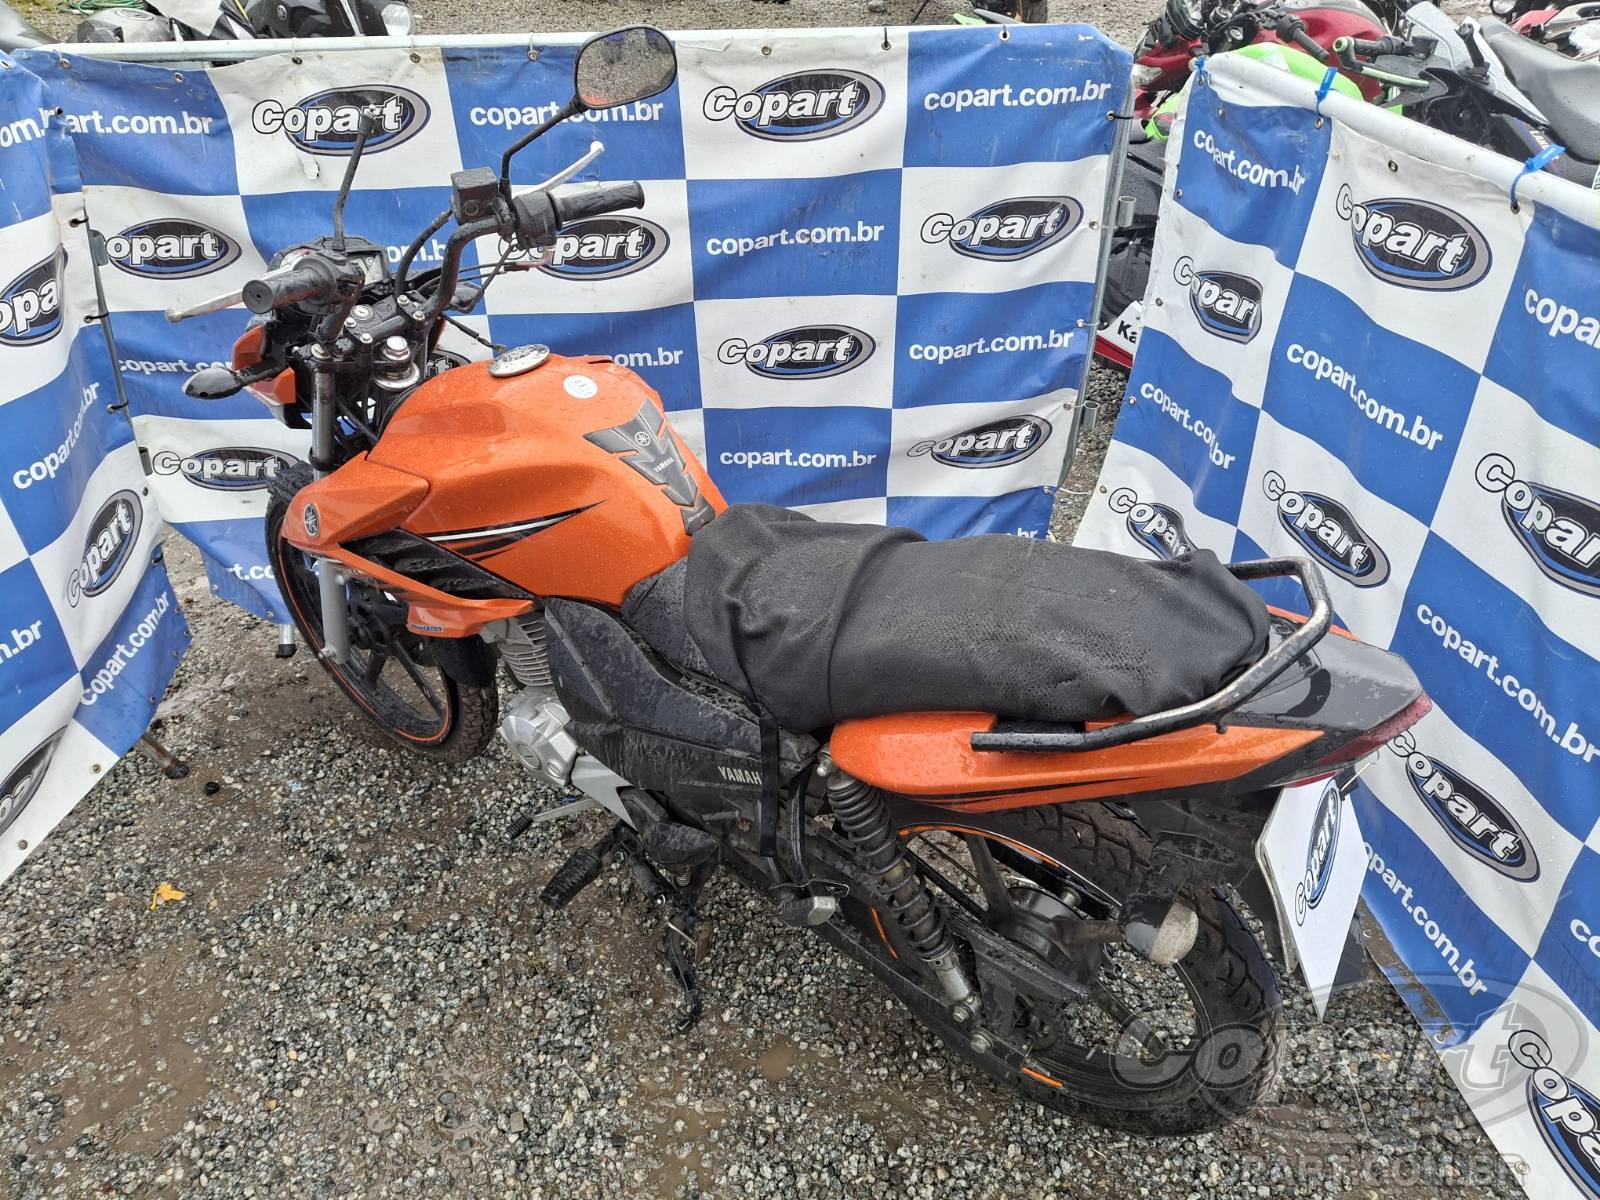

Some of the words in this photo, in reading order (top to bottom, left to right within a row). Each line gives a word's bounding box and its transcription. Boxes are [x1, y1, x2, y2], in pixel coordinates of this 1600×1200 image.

[702, 78, 860, 127] Copart
[923, 79, 1112, 113] copart.com.br
[105, 231, 220, 261] opart
[497, 225, 646, 267] Cpart
[706, 220, 885, 257] copart.com.br
[920, 201, 1064, 246] Copart
[1335, 182, 1471, 276] Copart
[1524, 288, 1600, 349] copa
[716, 334, 856, 370] Copart
[908, 329, 1075, 364] copart.com.br
[1285, 343, 1444, 453] copart.com.br
[719, 447, 878, 469] copart.com.br
[906, 419, 1036, 461] Copart
[152, 450, 281, 481] Copart
[1108, 486, 1190, 558] Copa
[1262, 469, 1370, 574] Copart
[67, 497, 133, 609] Copart
[1416, 603, 1600, 763] copart.com.br
[1384, 729, 1521, 862] Copart
[1294, 788, 1338, 927] Copart
